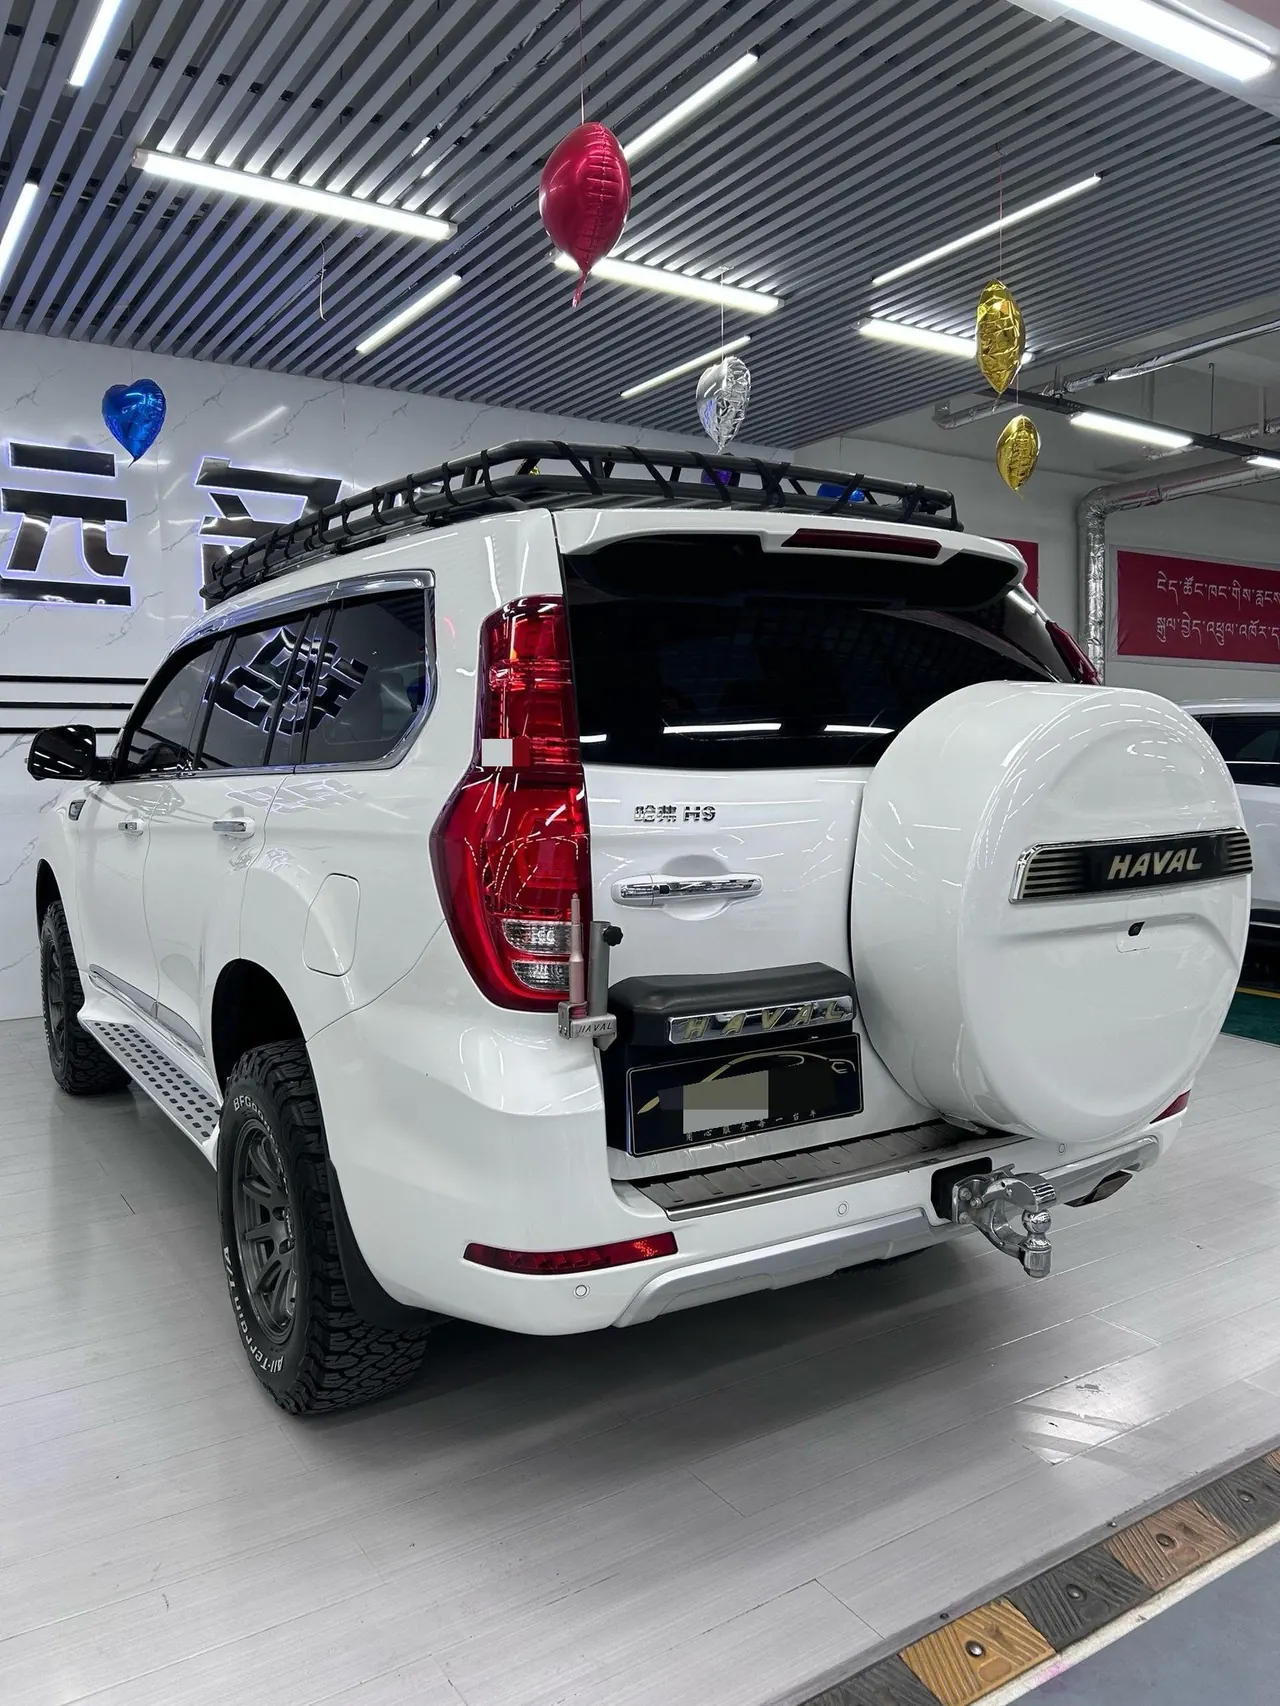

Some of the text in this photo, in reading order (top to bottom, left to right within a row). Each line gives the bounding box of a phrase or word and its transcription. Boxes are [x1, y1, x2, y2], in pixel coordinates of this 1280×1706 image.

[683, 805, 716, 822] H9
[1107, 847, 1203, 880] HAVAL
[578, 1022, 613, 1034] HAVAL
[682, 1000, 846, 1041] HAVAL
